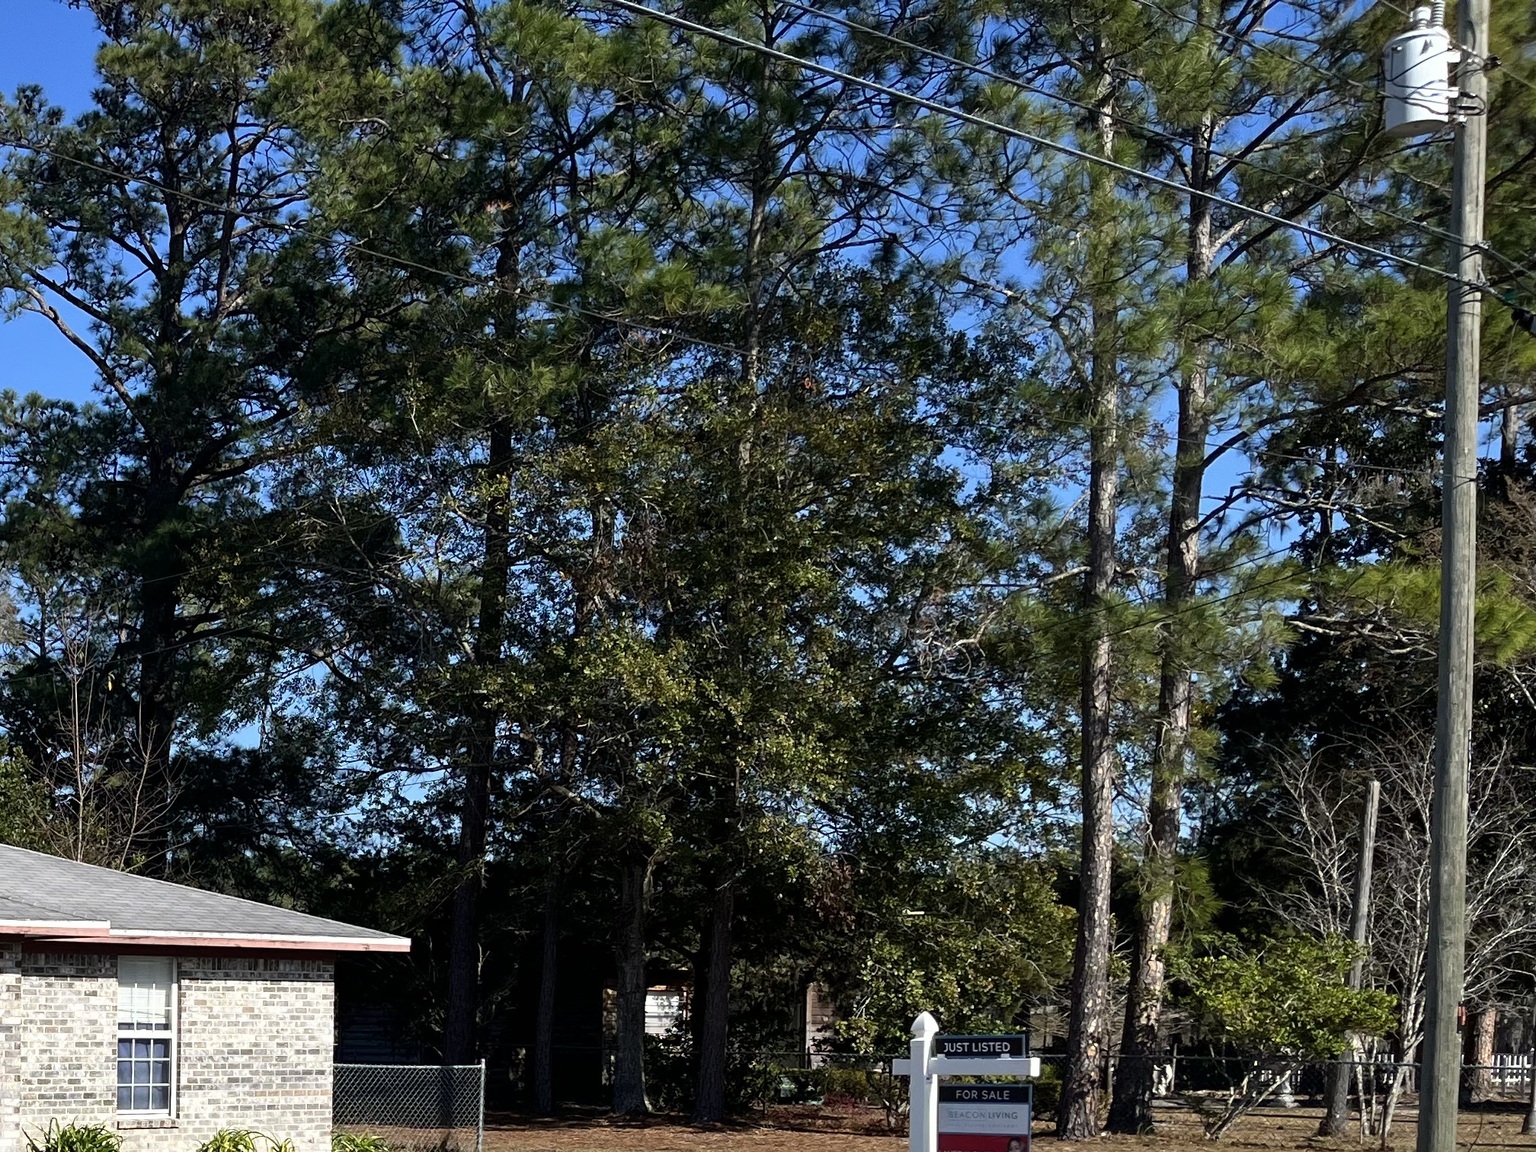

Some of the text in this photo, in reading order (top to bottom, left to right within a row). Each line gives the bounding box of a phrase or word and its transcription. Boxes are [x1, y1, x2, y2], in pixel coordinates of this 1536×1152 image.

[944, 1042, 1010, 1053] JUST LISTED
[955, 1090, 1010, 1100] FOR SALE
[948, 1110, 1018, 1120] BEACON LIVING
